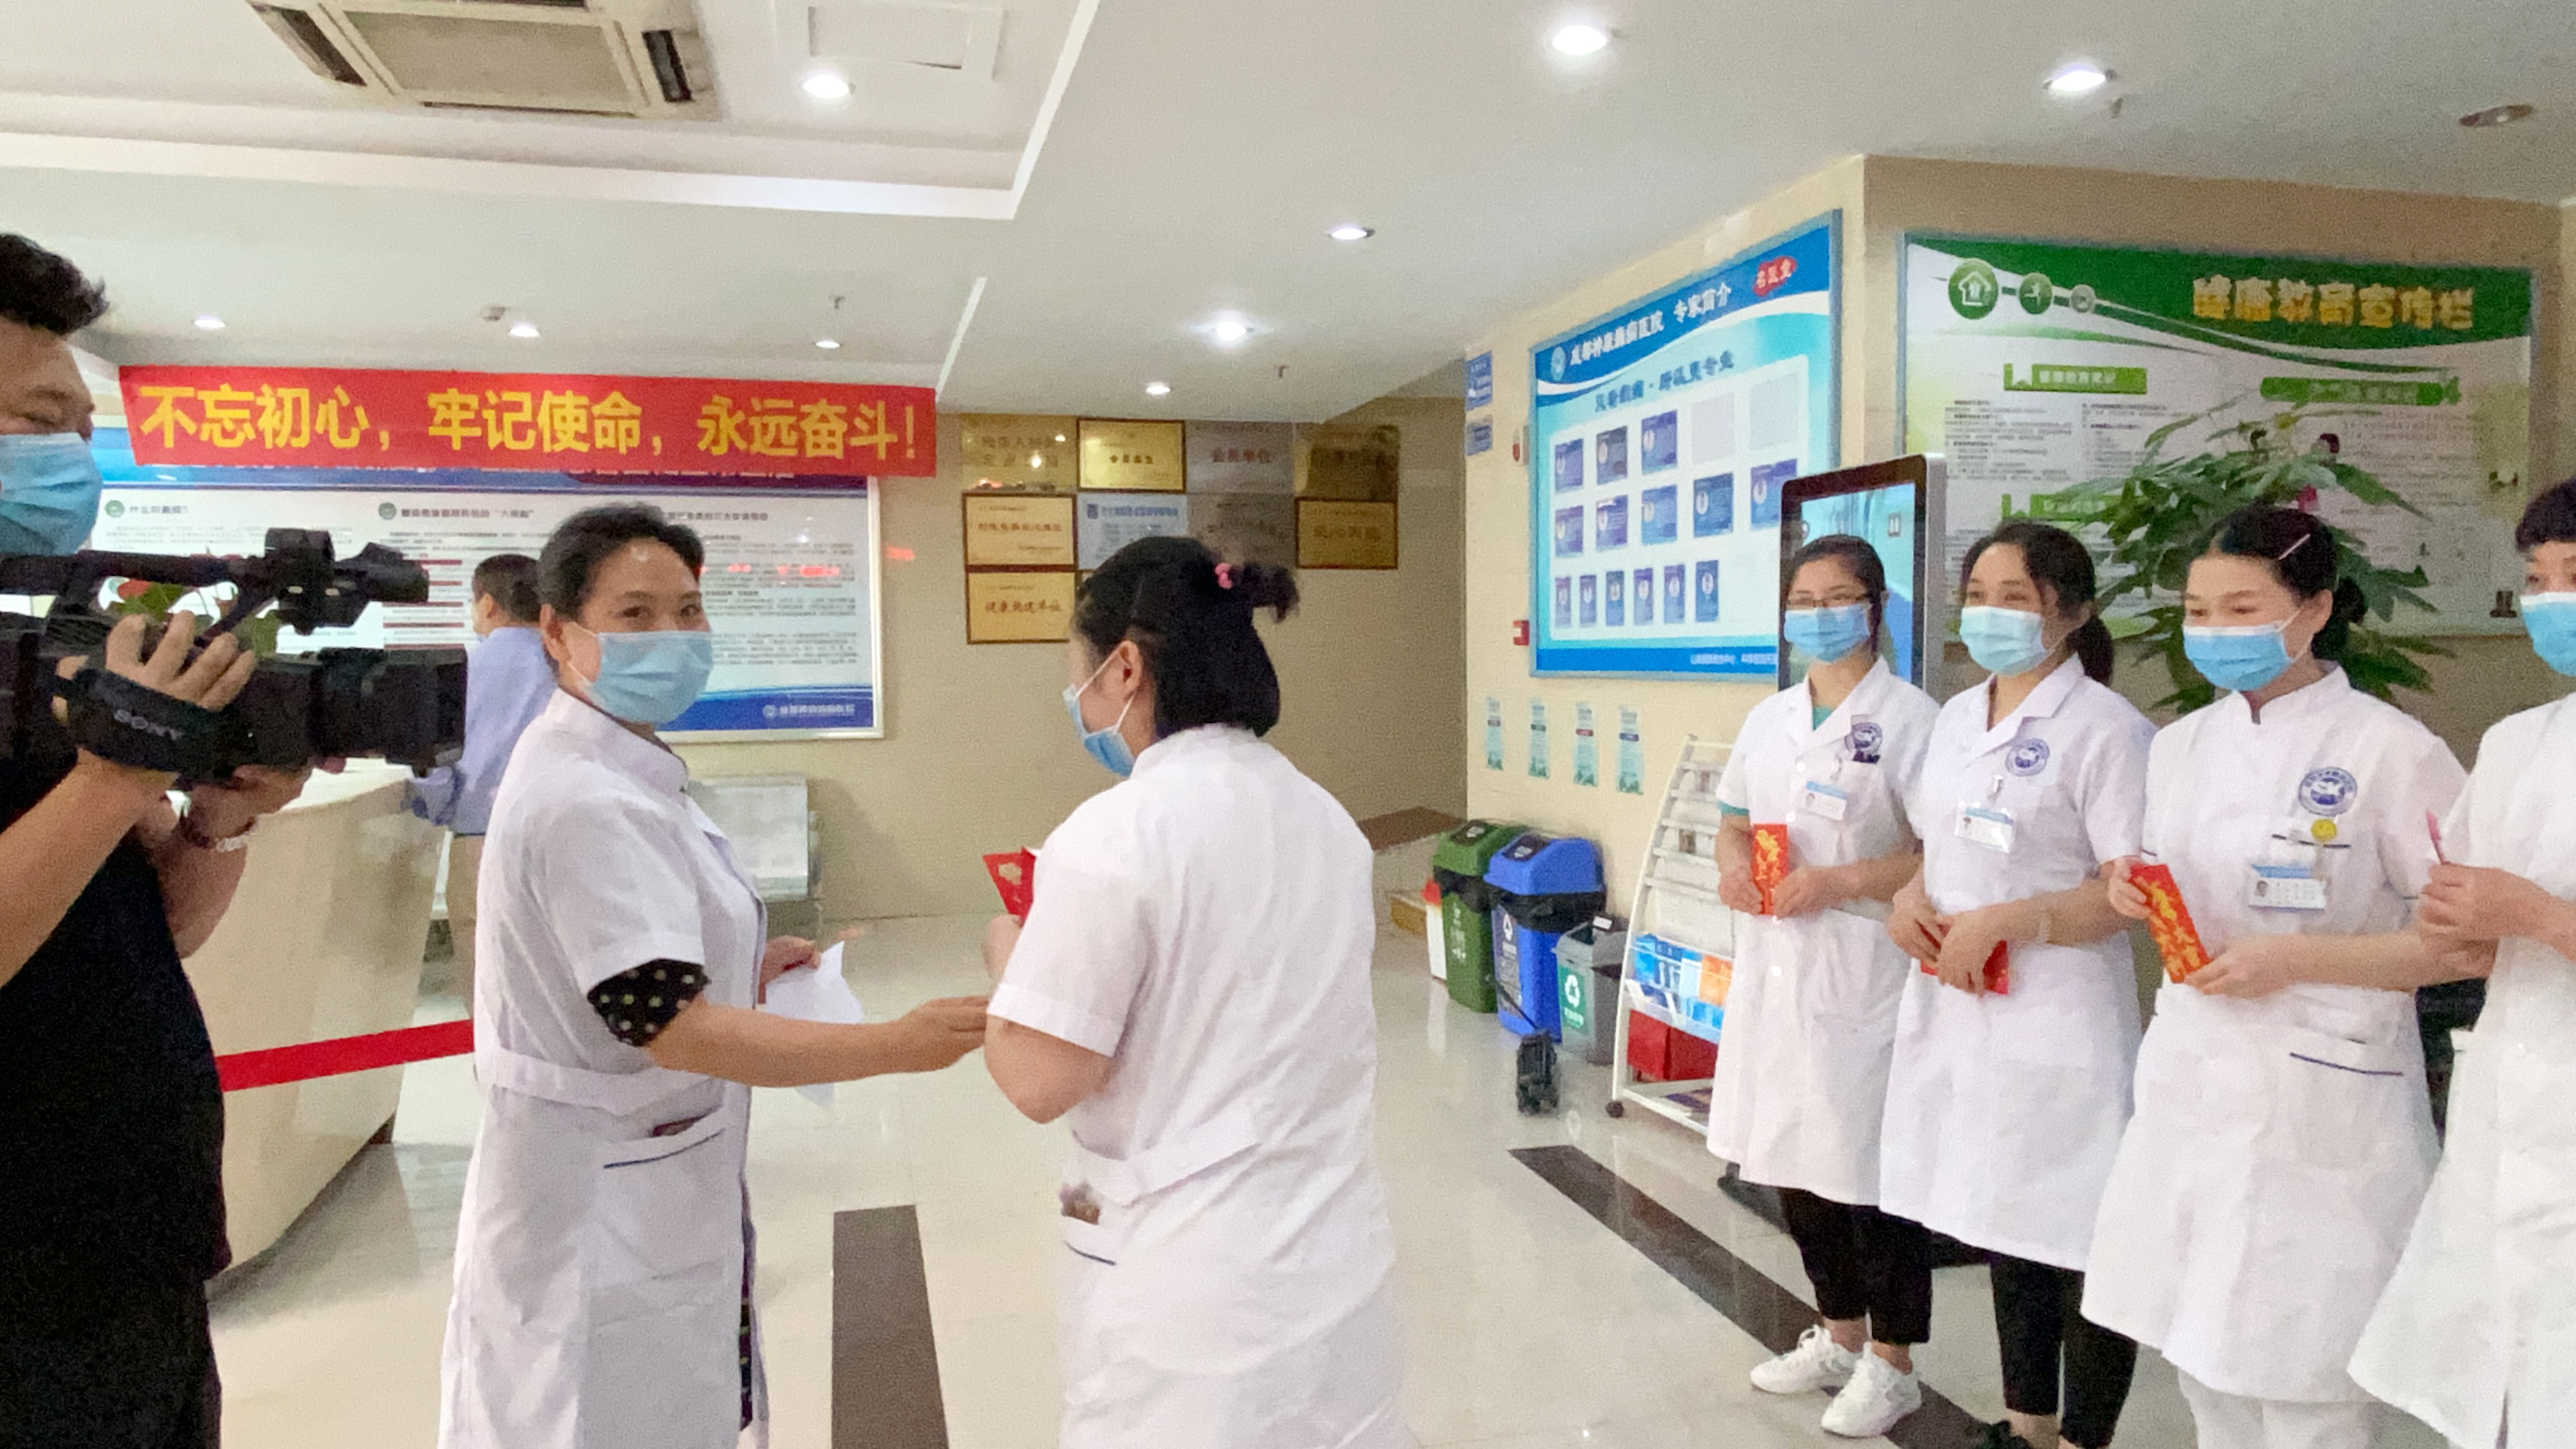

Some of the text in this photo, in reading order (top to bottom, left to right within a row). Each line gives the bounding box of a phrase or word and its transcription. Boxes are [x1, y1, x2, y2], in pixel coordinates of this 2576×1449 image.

[2193, 274, 2474, 329] 健康教育宣传栏
